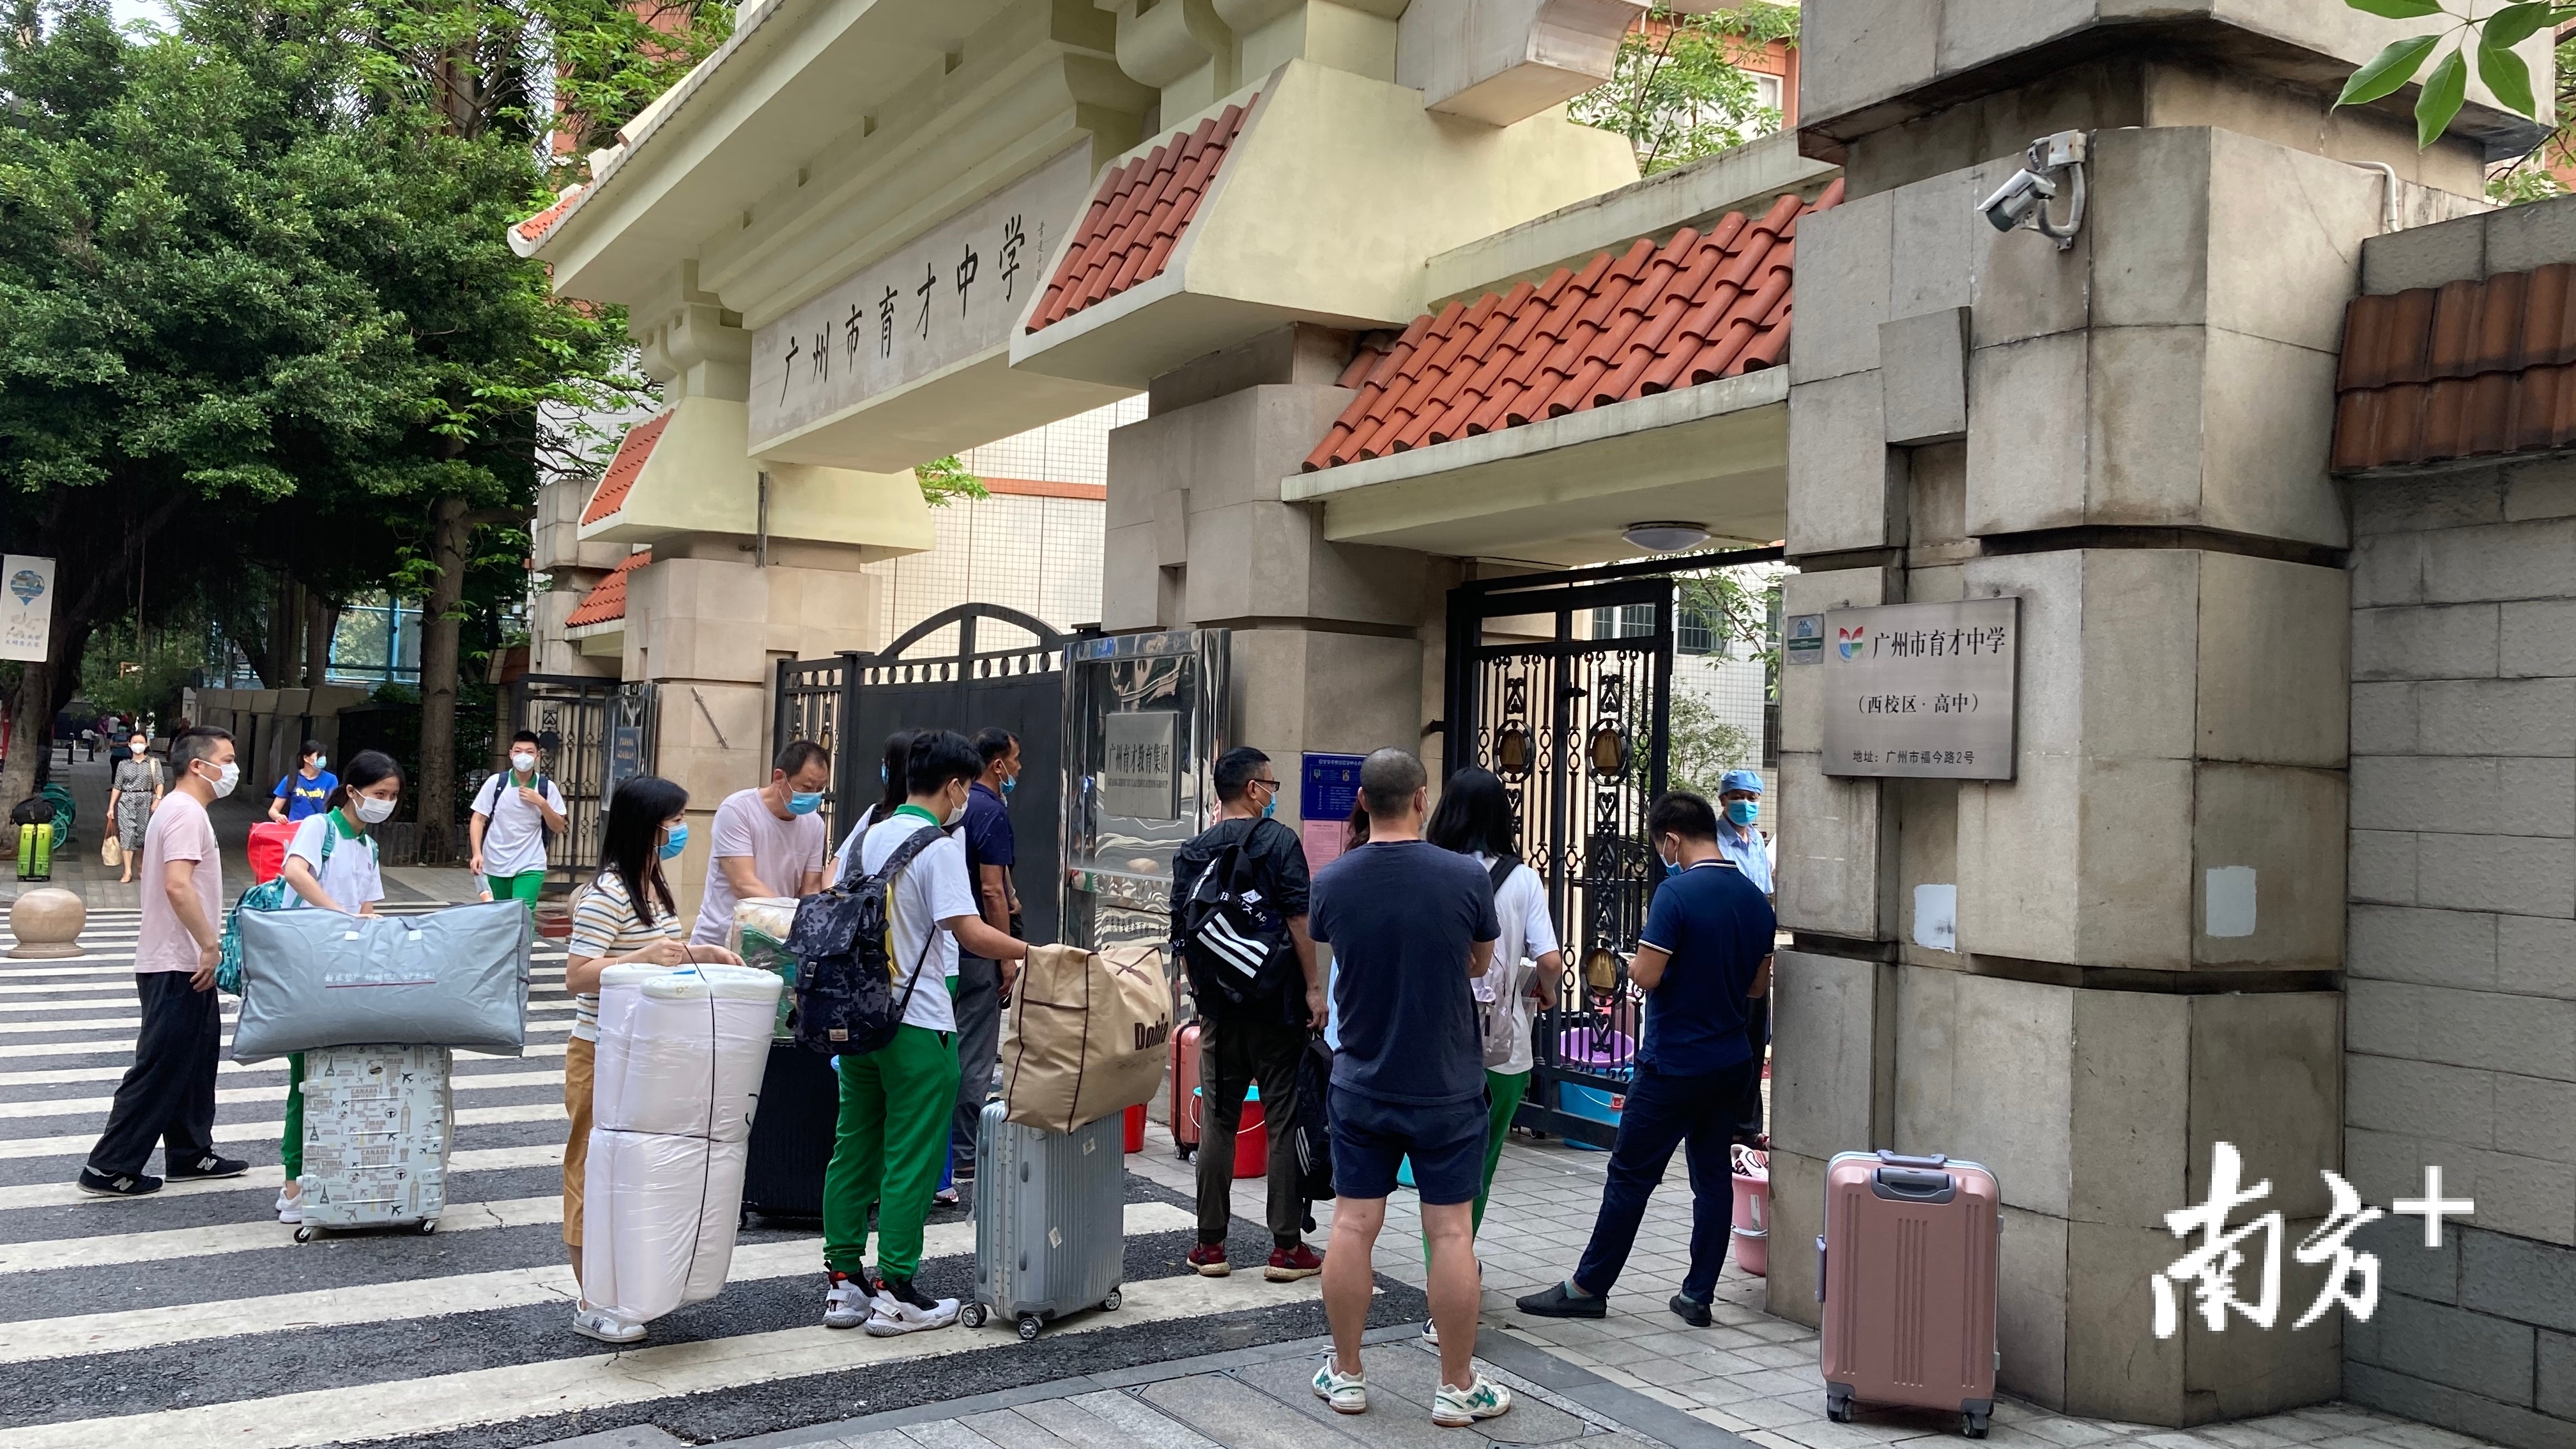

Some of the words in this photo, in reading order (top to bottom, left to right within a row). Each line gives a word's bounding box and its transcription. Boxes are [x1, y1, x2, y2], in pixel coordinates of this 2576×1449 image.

[780, 214, 1025, 408] 广州市育才中学
[1872, 626, 2005, 659] 广州市育才中学
[1108, 743, 1169, 774] 广州育才教育集团
[1853, 749, 1975, 765] 地址：广州市福今路2号
[1135, 1012, 1169, 1050] Dohia
